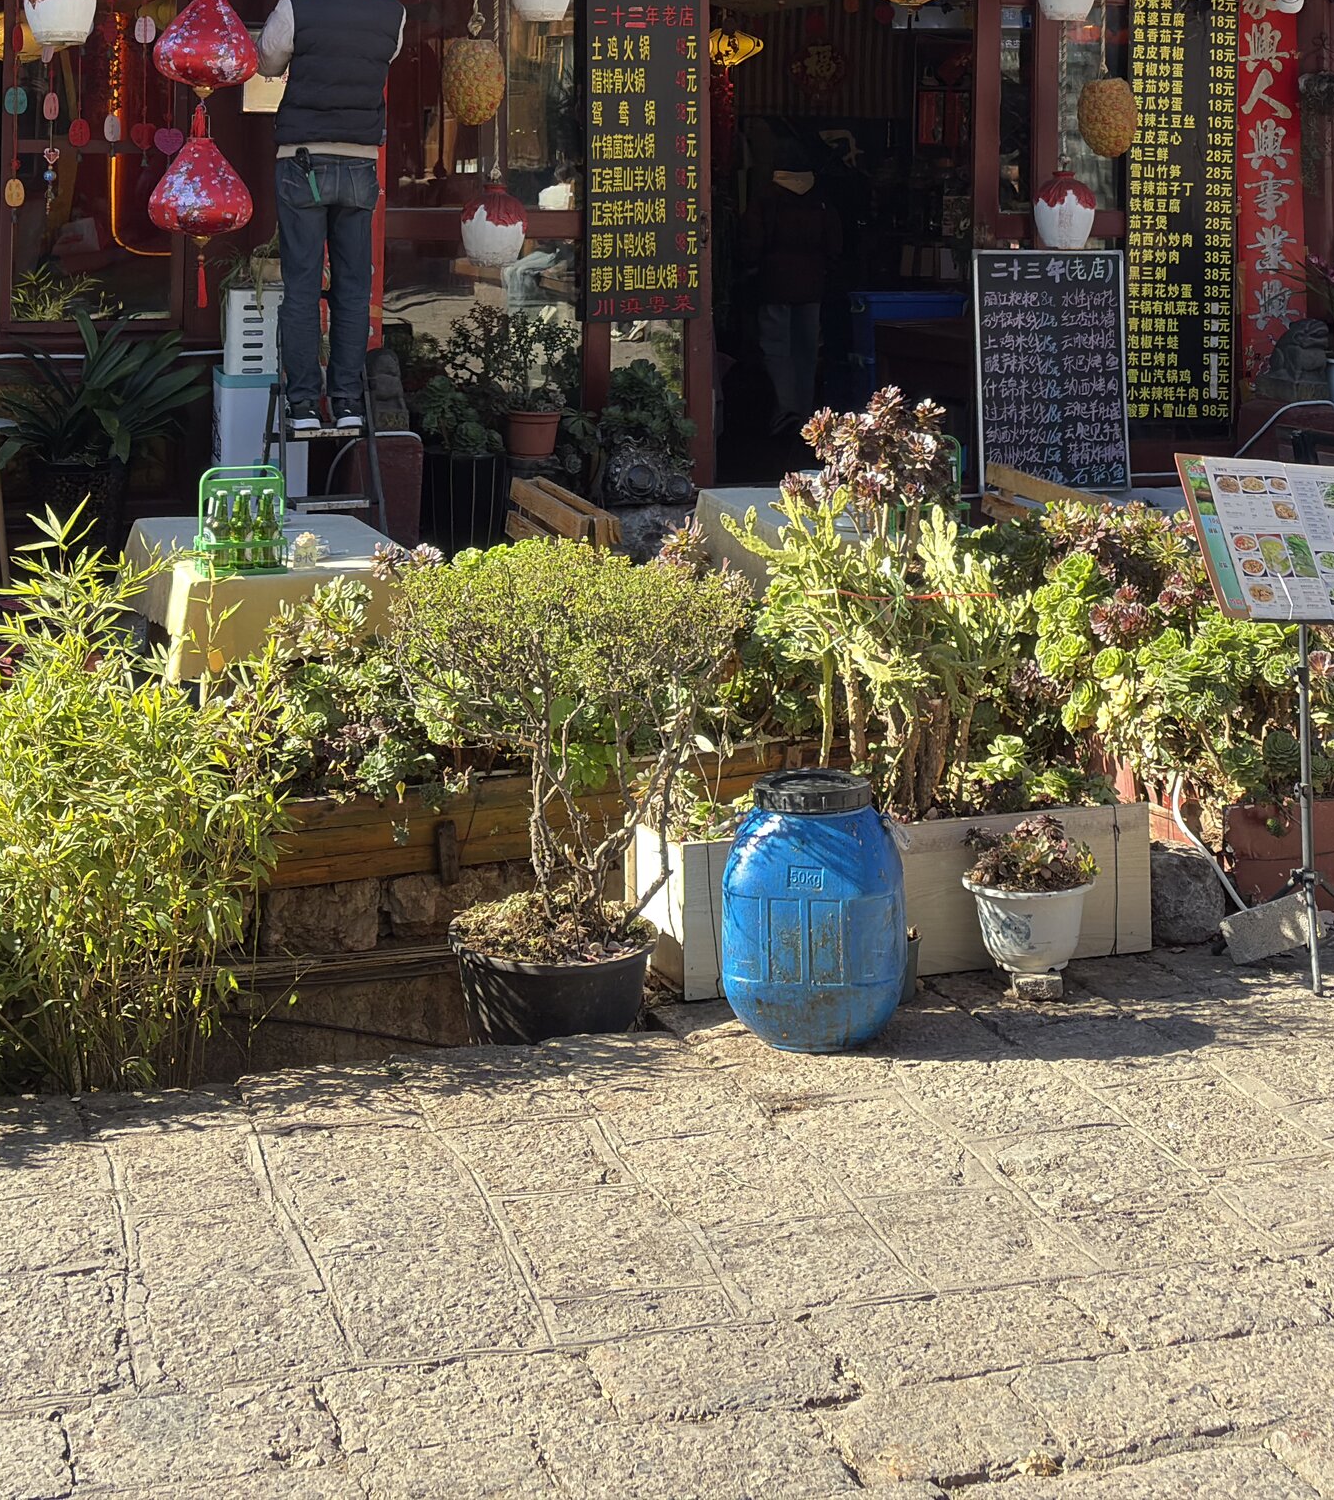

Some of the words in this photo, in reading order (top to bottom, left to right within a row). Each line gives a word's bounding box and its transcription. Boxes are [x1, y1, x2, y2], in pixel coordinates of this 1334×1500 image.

[1210, 0, 1237, 12] 12元
[593, 4, 695, 28] 二十三年老店
[1133, 11, 1185, 28] 麻婆豆腐
[1210, 15, 1236, 29] 18元
[1133, 28, 1185, 44] 鱼香茄子
[1210, 32, 1236, 46] 18元
[591, 35, 651, 61] 土鸡火锅
[1133, 44, 1185, 61] 虎皮青椒
[1209, 49, 1236, 63] 18元
[1132, 61, 1184, 78] 青椒炒蛋
[1209, 65, 1235, 79] 18元
[591, 67, 646, 94] 腊排骨火锅
[1132, 78, 1183, 95] 番茄炒蛋
[1208, 82, 1235, 96] 18元
[1133, 95, 1183, 111] 苦瓜炒蛋
[1208, 99, 1234, 113] 18元
[591, 100, 656, 127] 鸳鸯锅
[1207, 116, 1234, 130] 16元
[590, 133, 656, 160] 什锦菌菇火锅
[1131, 130, 1182, 145] 豆皮菜心
[1207, 133, 1234, 147] 18元
[1130, 147, 1169, 162] 地三鲜
[1206, 150, 1233, 164] 28元
[590, 165, 666, 193] 正宗黑山羊火锅
[1130, 163, 1182, 179] 雪山竹笋
[1205, 166, 1233, 180] 28元
[1130, 180, 1194, 196] 香辣茄子丁
[1205, 183, 1232, 197] 28元
[590, 197, 666, 226] 正宗牦牛肉火锅
[1129, 197, 1181, 213] 铁板豆腐
[1205, 200, 1232, 214] 28元
[1129, 214, 1168, 230] 茄子煲
[1205, 217, 1232, 231] 28元
[590, 231, 657, 259] 酸萝卜鸭火锅
[1129, 231, 1193, 248] 纳西小炒肉
[1204, 234, 1232, 248] 38元
[1129, 248, 1180, 264] 竹笋炒肉
[1204, 251, 1231, 265] 38元
[590, 263, 678, 293] 酸萝卜雪山鱼火锅
[1129, 266, 1167, 281] 黑三剁
[1204, 268, 1231, 282] 38元
[1128, 283, 1193, 299] 茉莉花炒蛋
[1204, 285, 1231, 299] 38元
[1128, 300, 1199, 315] 干锅有机菜花
[1203, 301, 1231, 316] 3元
[1127, 317, 1179, 332] 青椒猪肚
[1203, 318, 1230, 333] 5元
[1127, 334, 1179, 350] 泡椒牛蛙
[1203, 336, 1230, 350] 5元
[1127, 351, 1178, 367] 东巴烤肉
[1202, 352, 1230, 367] 5元
[1127, 368, 1191, 384] 雪山汽锅鸡
[1202, 369, 1229, 384] 6元
[1126, 385, 1199, 401] 小米辣牦牛肉
[1202, 386, 1229, 401] 6元
[1127, 403, 1199, 418] 酸萝卜雪山鱼
[1201, 403, 1229, 418] 98元
[789, 869, 822, 889] 50kg
